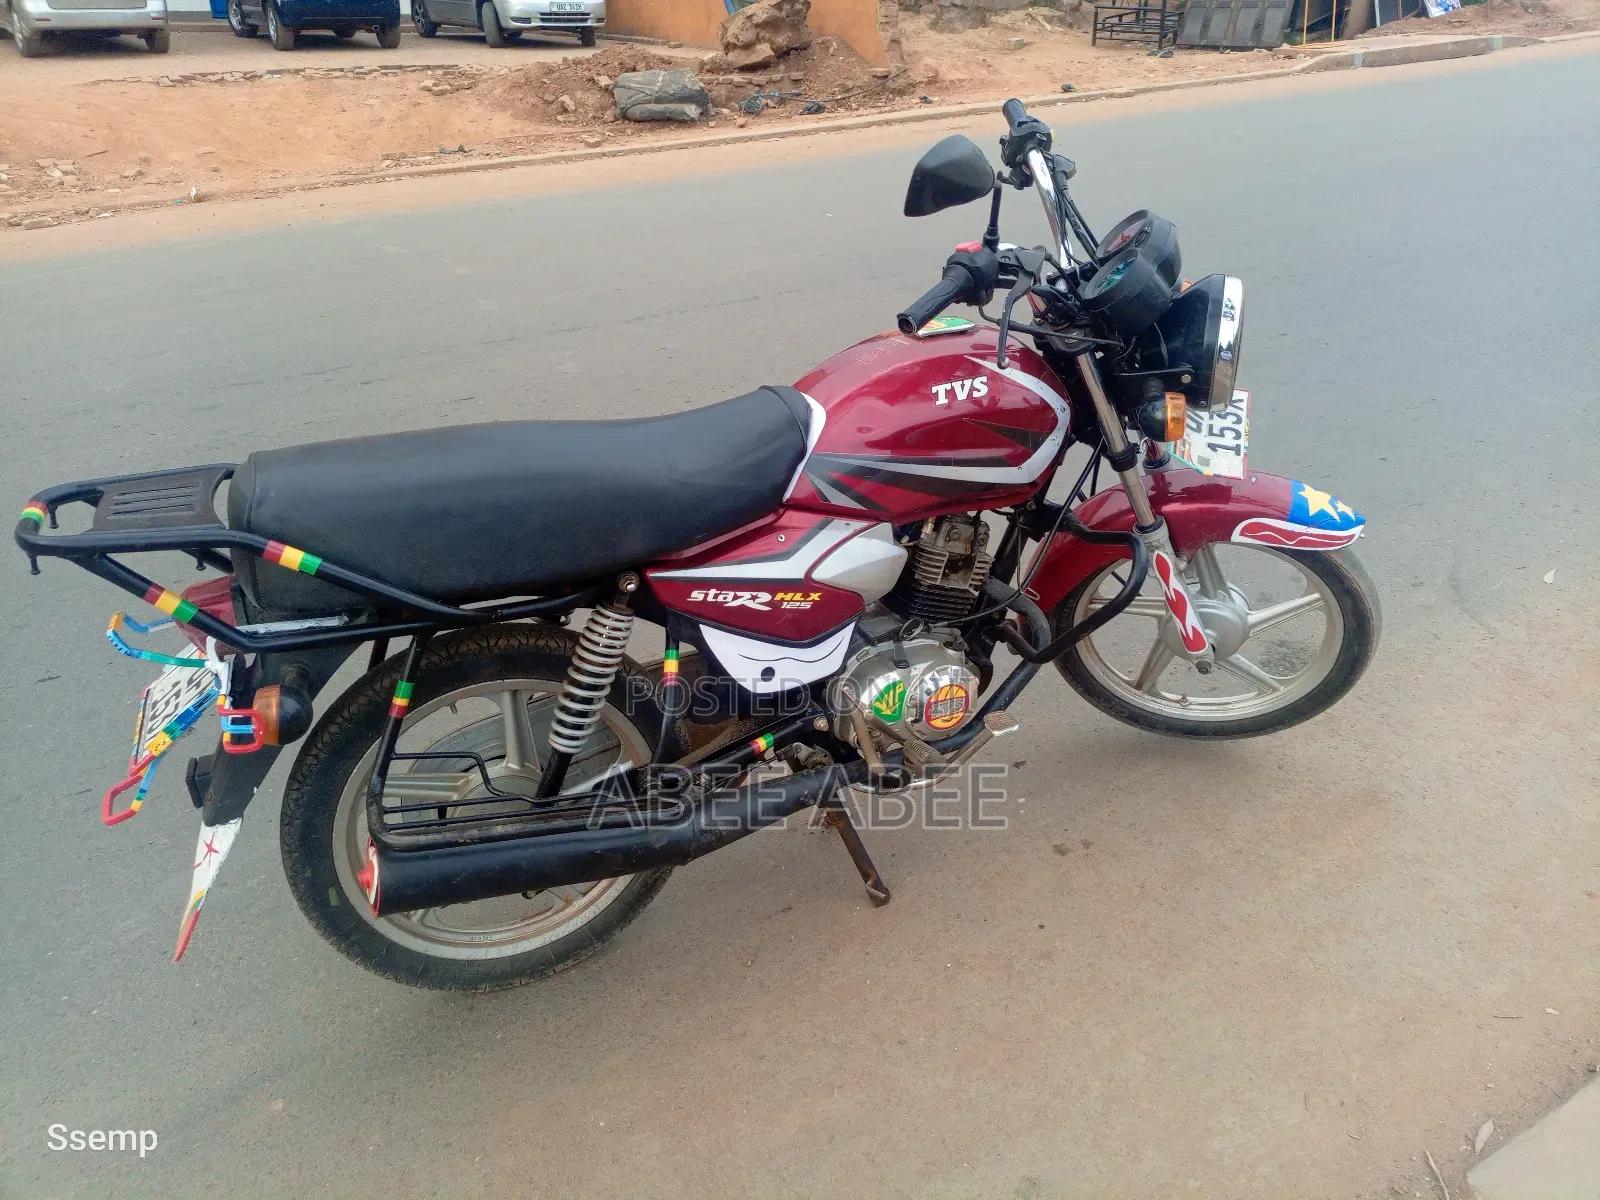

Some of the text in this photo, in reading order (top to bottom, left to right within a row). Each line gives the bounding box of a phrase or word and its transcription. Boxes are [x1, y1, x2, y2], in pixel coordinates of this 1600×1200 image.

[931, 376, 988, 406] TVS
[774, 592, 822, 601] HLX
[781, 601, 813, 609] 125
[873, 682, 905, 714] VIP
